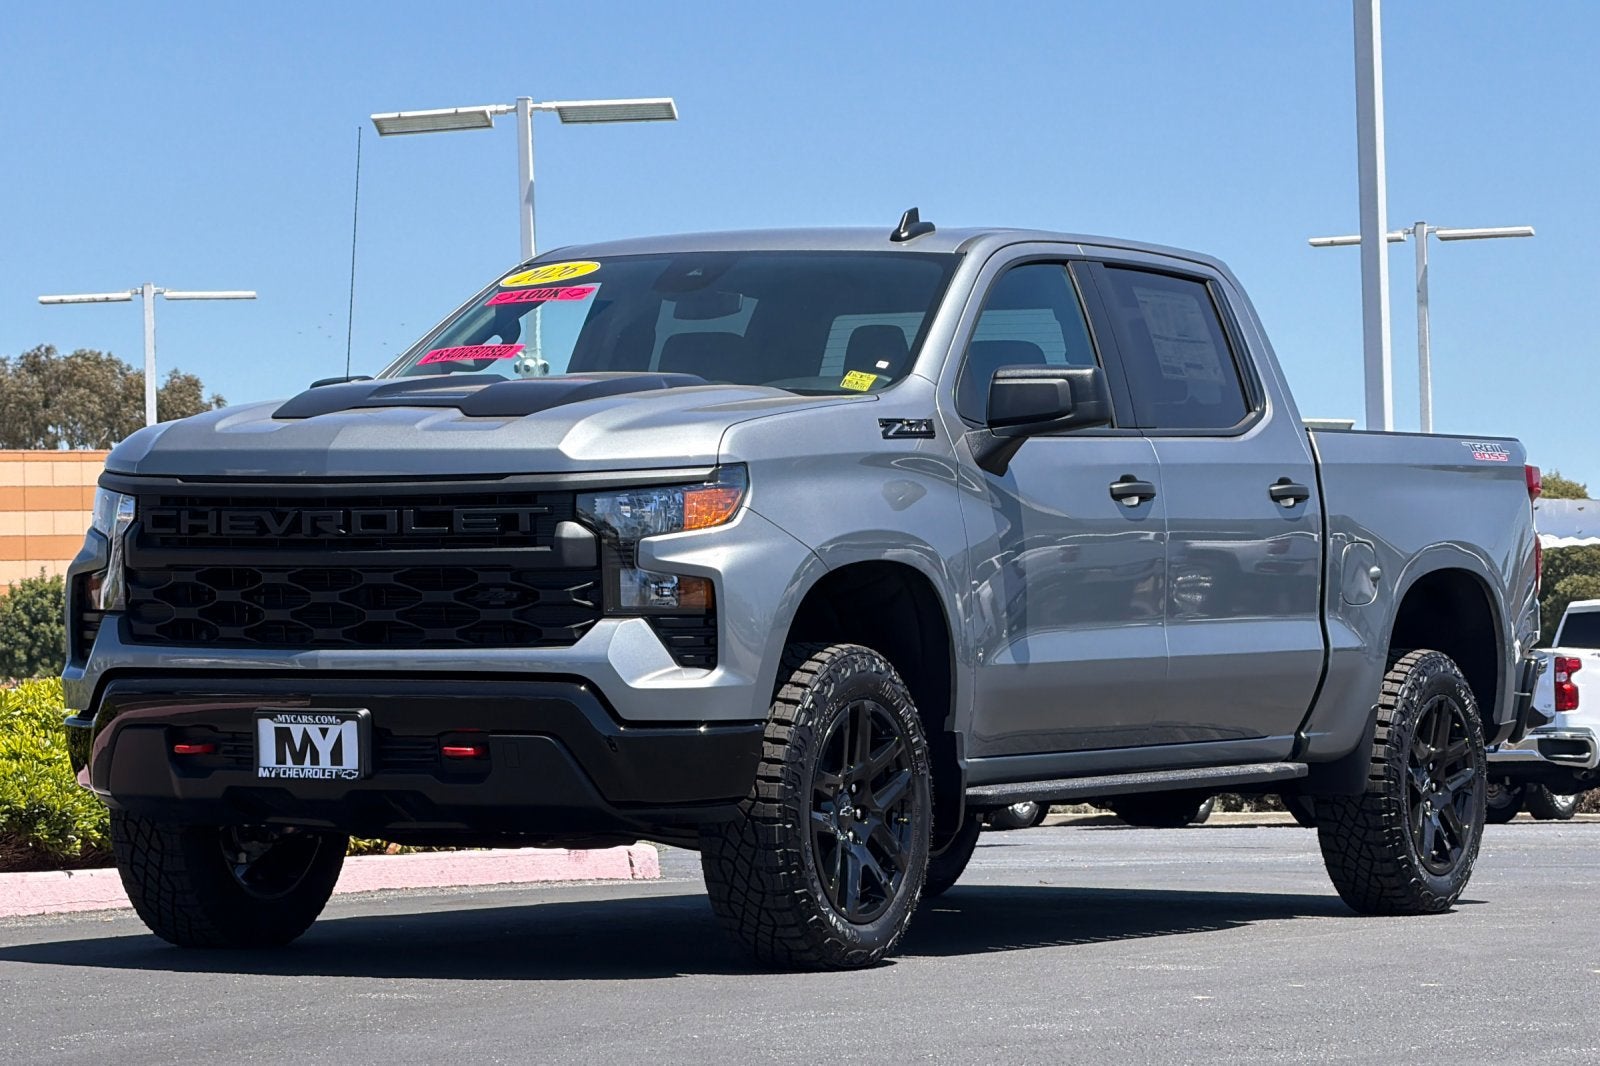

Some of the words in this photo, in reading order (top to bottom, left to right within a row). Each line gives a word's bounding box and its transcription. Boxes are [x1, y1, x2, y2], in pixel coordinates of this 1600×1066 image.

[510, 265, 579, 284] 2026
[516, 288, 565, 300] LOOK
[427, 349, 448, 361] AS
[443, 346, 514, 360] ADVERTISED
[1461, 441, 1510, 455] TRAIL
[1473, 452, 1509, 462] BOSS
[144, 506, 552, 537] CHEVROLET
[276, 714, 337, 725] MYCARS.COM
[274, 726, 343, 767] MY
[258, 767, 276, 778] MY
[280, 768, 338, 779] CHEVROLET
